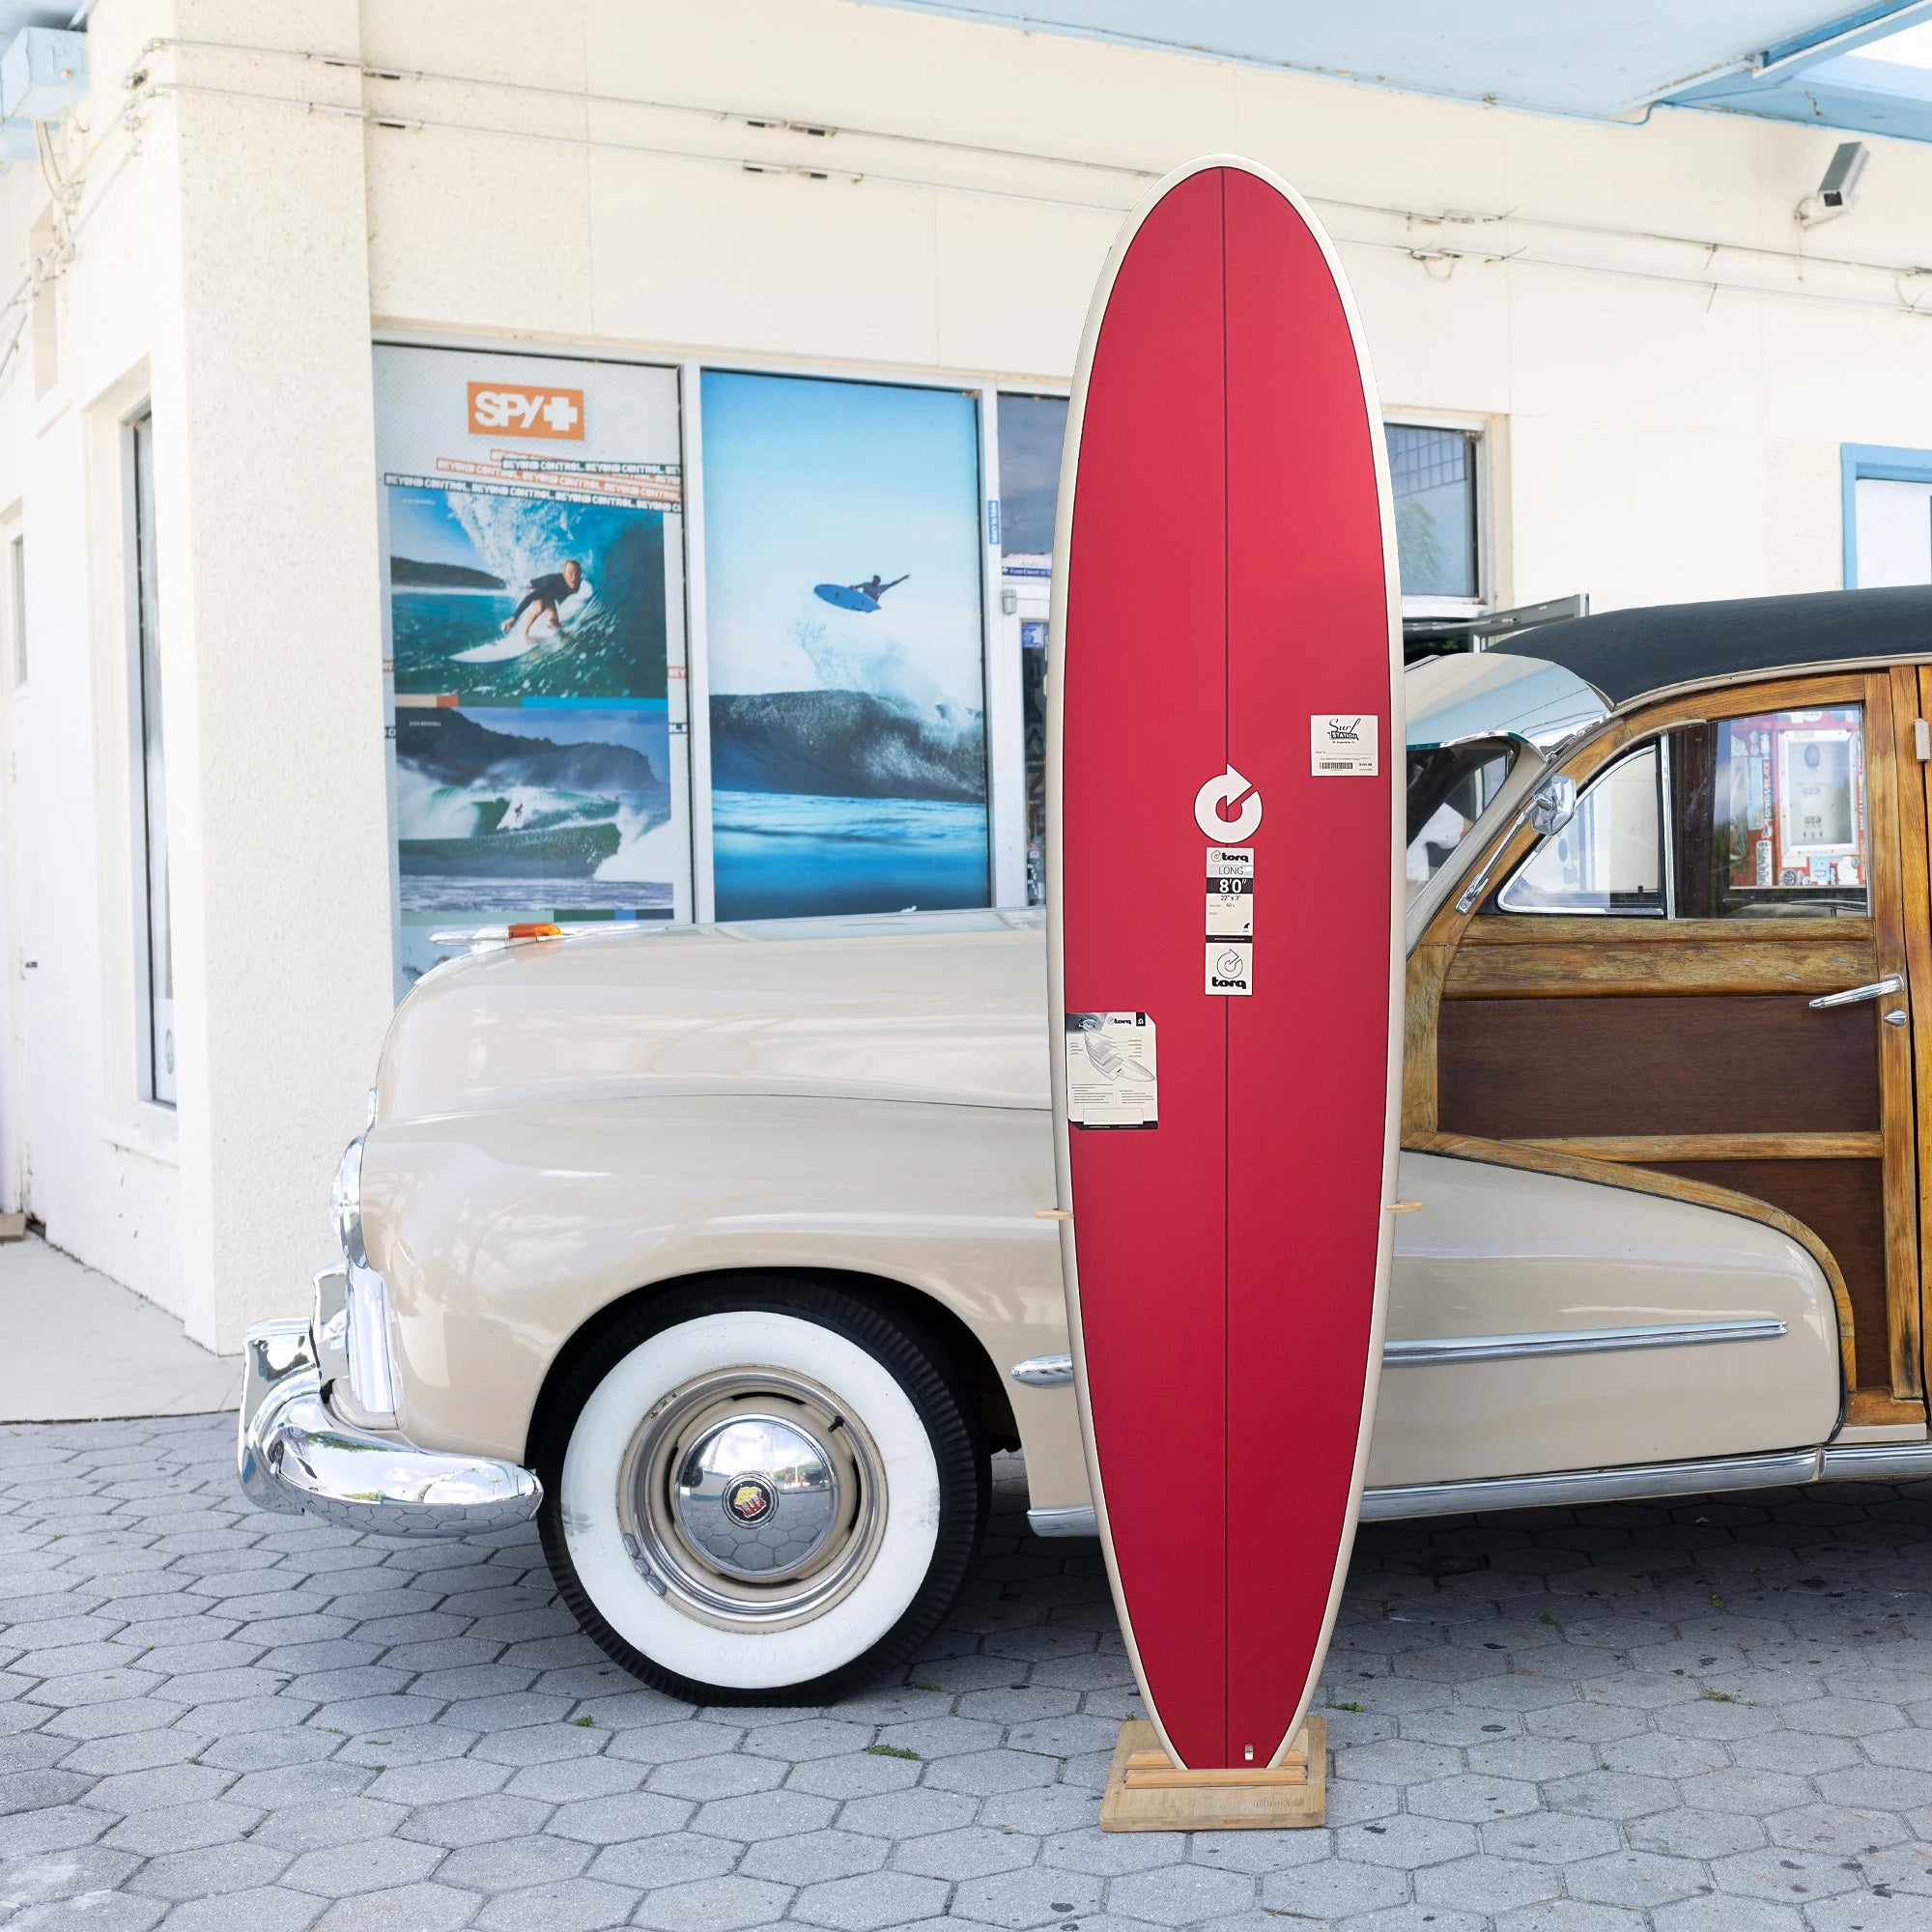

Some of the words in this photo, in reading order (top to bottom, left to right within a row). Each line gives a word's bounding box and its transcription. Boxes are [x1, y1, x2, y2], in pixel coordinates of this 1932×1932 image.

[502, 460, 539, 470] BEYOND
[585, 463, 621, 472] BEYOND
[385, 474, 424, 487] BEYOND
[471, 484, 509, 496] BEYOND
[555, 492, 591, 504] BEYOND
[637, 499, 671, 512] BEYOND
[1329, 718, 1361, 734] Surf
[1222, 852, 1248, 863] torq
[1218, 866, 1244, 875] LONG
[1219, 879, 1247, 894] 8'0"
[1211, 977, 1246, 989] torq
